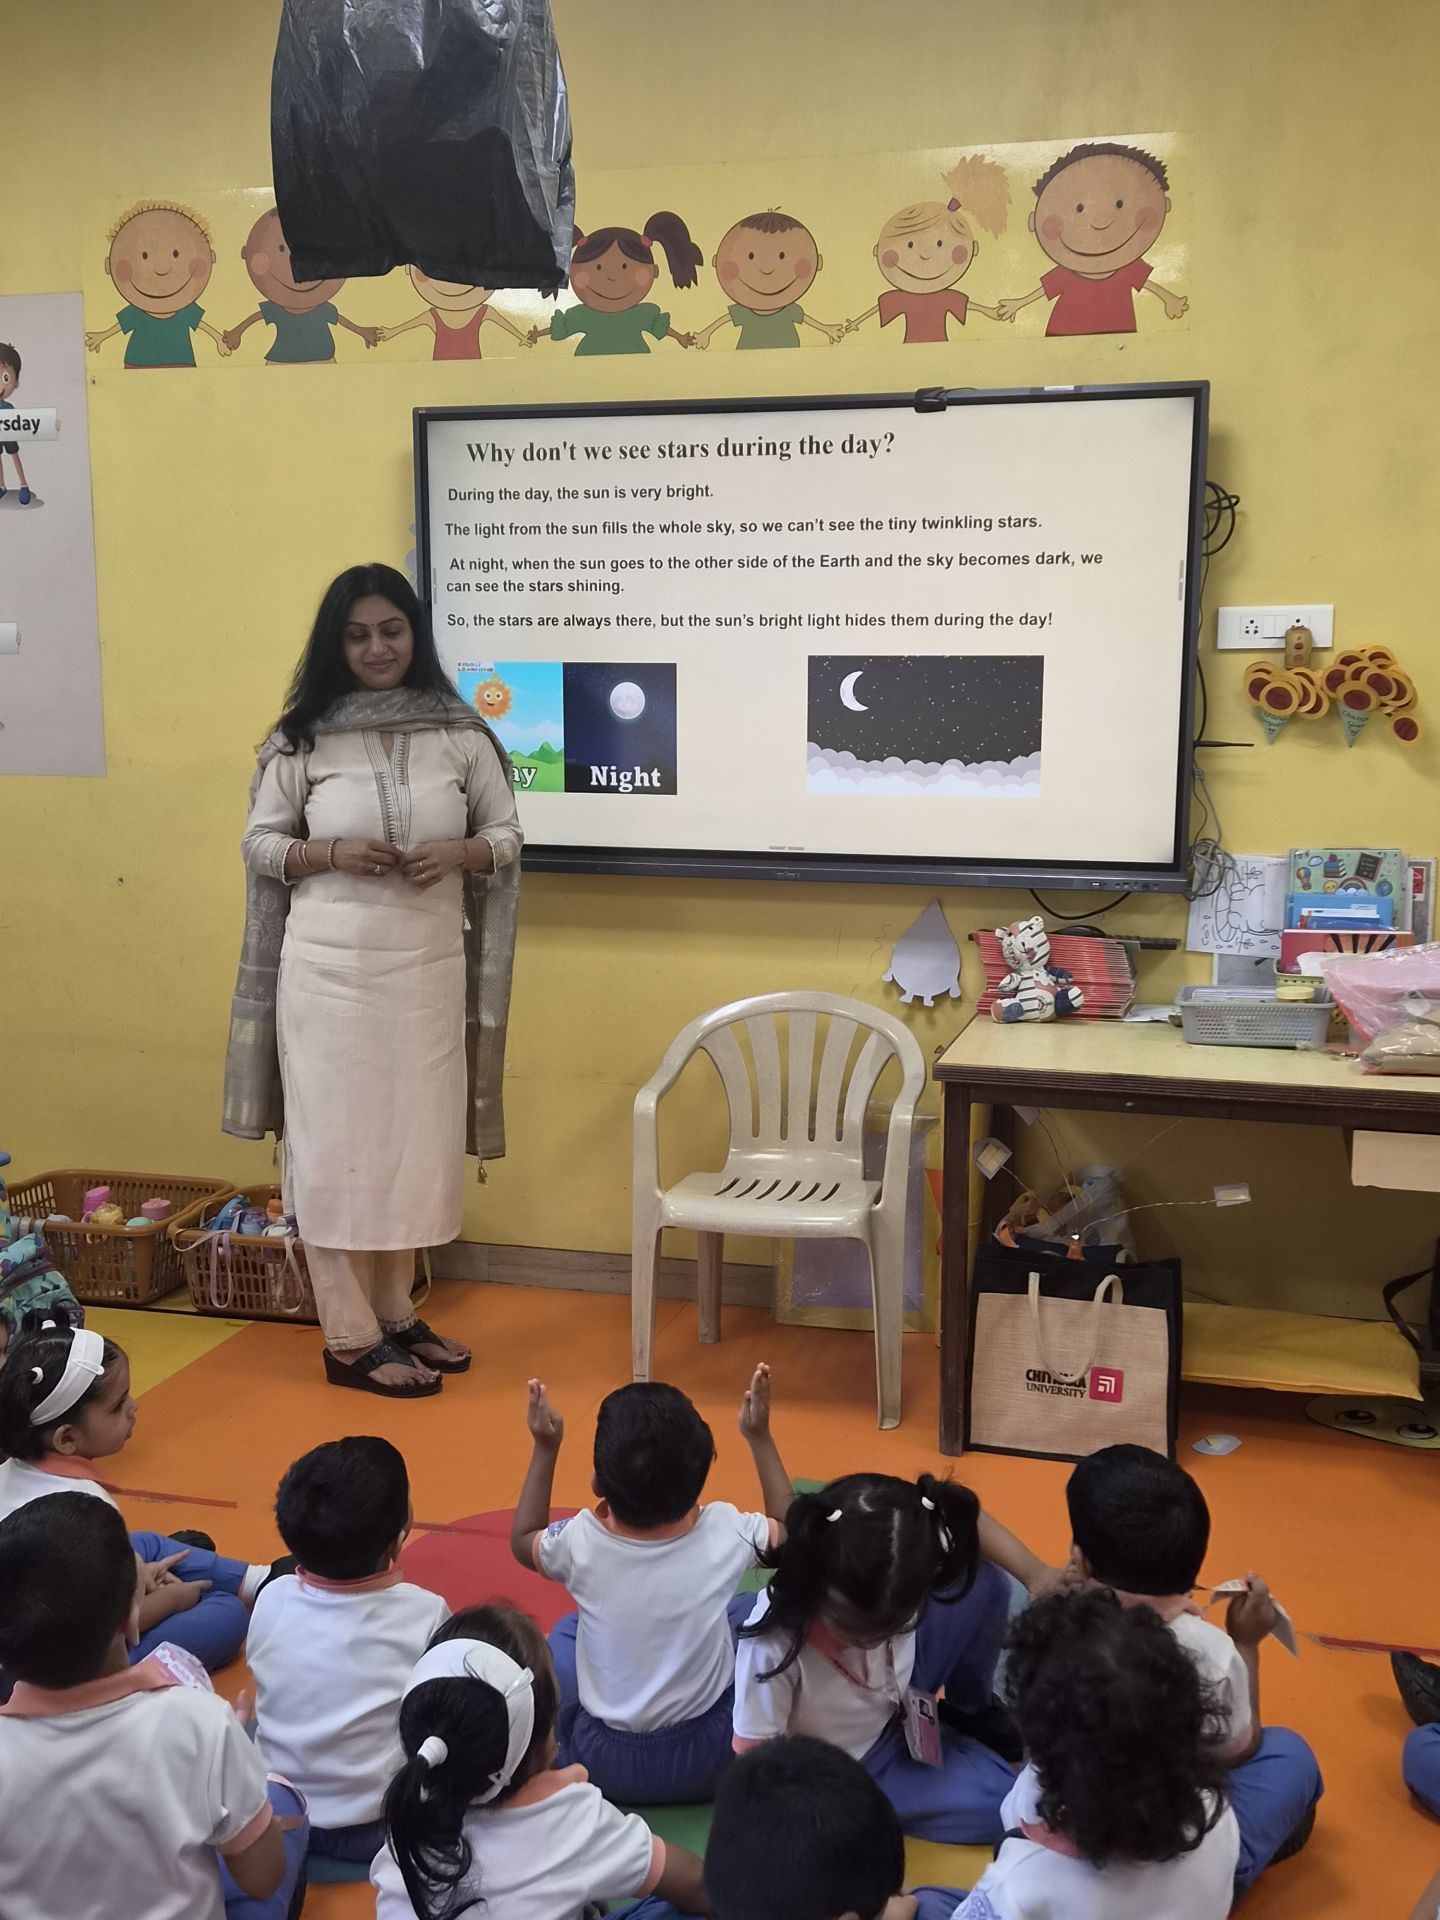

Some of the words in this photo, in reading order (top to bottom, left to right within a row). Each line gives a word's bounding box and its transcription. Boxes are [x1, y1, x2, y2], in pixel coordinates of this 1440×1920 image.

[0, 414, 41, 435] sday
[466, 442, 516, 468] Why
[522, 440, 577, 462] don't
[582, 445, 613, 461] we
[618, 444, 651, 460] see
[657, 440, 710, 459] stars
[716, 435, 793, 462] during
[798, 434, 834, 456] the
[840, 431, 896, 460] day?
[448, 487, 495, 505] During
[498, 487, 521, 501] the
[524, 486, 553, 504] day,
[556, 486, 580, 500] the
[583, 488, 610, 500] sun
[614, 485, 627, 499] is
[630, 487, 663, 502] very
[666, 483, 714, 501] bright.
[444, 522, 471, 536] The
[474, 522, 506, 539] light
[508, 521, 542, 536] from
[544, 521, 568, 536] the
[571, 524, 598, 535] sun
[601, 520, 630, 535] fills
[631, 520, 655, 535] the
[658, 519, 703, 534] whole
[706, 519, 735, 537] sky,
[739, 522, 758, 533] so
[761, 521, 784, 533] we
[828, 520, 856, 532] see
[859, 516, 884, 531] the
[887, 516, 918, 534] tiny
[921, 514, 993, 533] twinkling
[997, 514, 1043, 529] stars.
[449, 557, 466, 571] At
[468, 556, 508, 574] night,
[511, 556, 550, 571] when
[552, 556, 578, 571] the
[579, 559, 606, 570] sun
[609, 559, 645, 573] goes
[648, 556, 664, 570] to
[666, 555, 691, 570] the
[694, 555, 734, 569] other
[737, 555, 769, 569] side
[772, 554, 789, 569] of
[791, 554, 816, 569] the
[819, 553, 860, 568] Earth
[864, 553, 893, 568] and
[897, 552, 922, 567] the
[926, 552, 955, 570] sky
[958, 552, 1031, 567] becomes
[1035, 550, 1075, 567] dark,
[1080, 553, 1104, 565] we
[446, 582, 471, 593] can
[474, 581, 499, 593] see
[502, 578, 525, 593] the
[528, 579, 564, 593] stars
[567, 578, 625, 596] shining.
[447, 613, 470, 629] So,
[472, 613, 495, 627] the
[498, 614, 534, 627] stars
[536, 616, 560, 627] are
[563, 613, 612, 630] always
[615, 613, 657, 629] there,
[660, 613, 685, 627] but
[687, 613, 711, 627] the
[759, 613, 804, 630] bright
[807, 613, 841, 630] light
[844, 613, 887, 627] hides
[890, 612, 930, 627] them
[933, 612, 985, 630] during
[989, 612, 1014, 626] the
[1018, 611, 1053, 630] day!
[511, 766, 538, 788] ay
[589, 765, 662, 793] Night
[1026, 1382, 1087, 1399] UNIVERSITY
